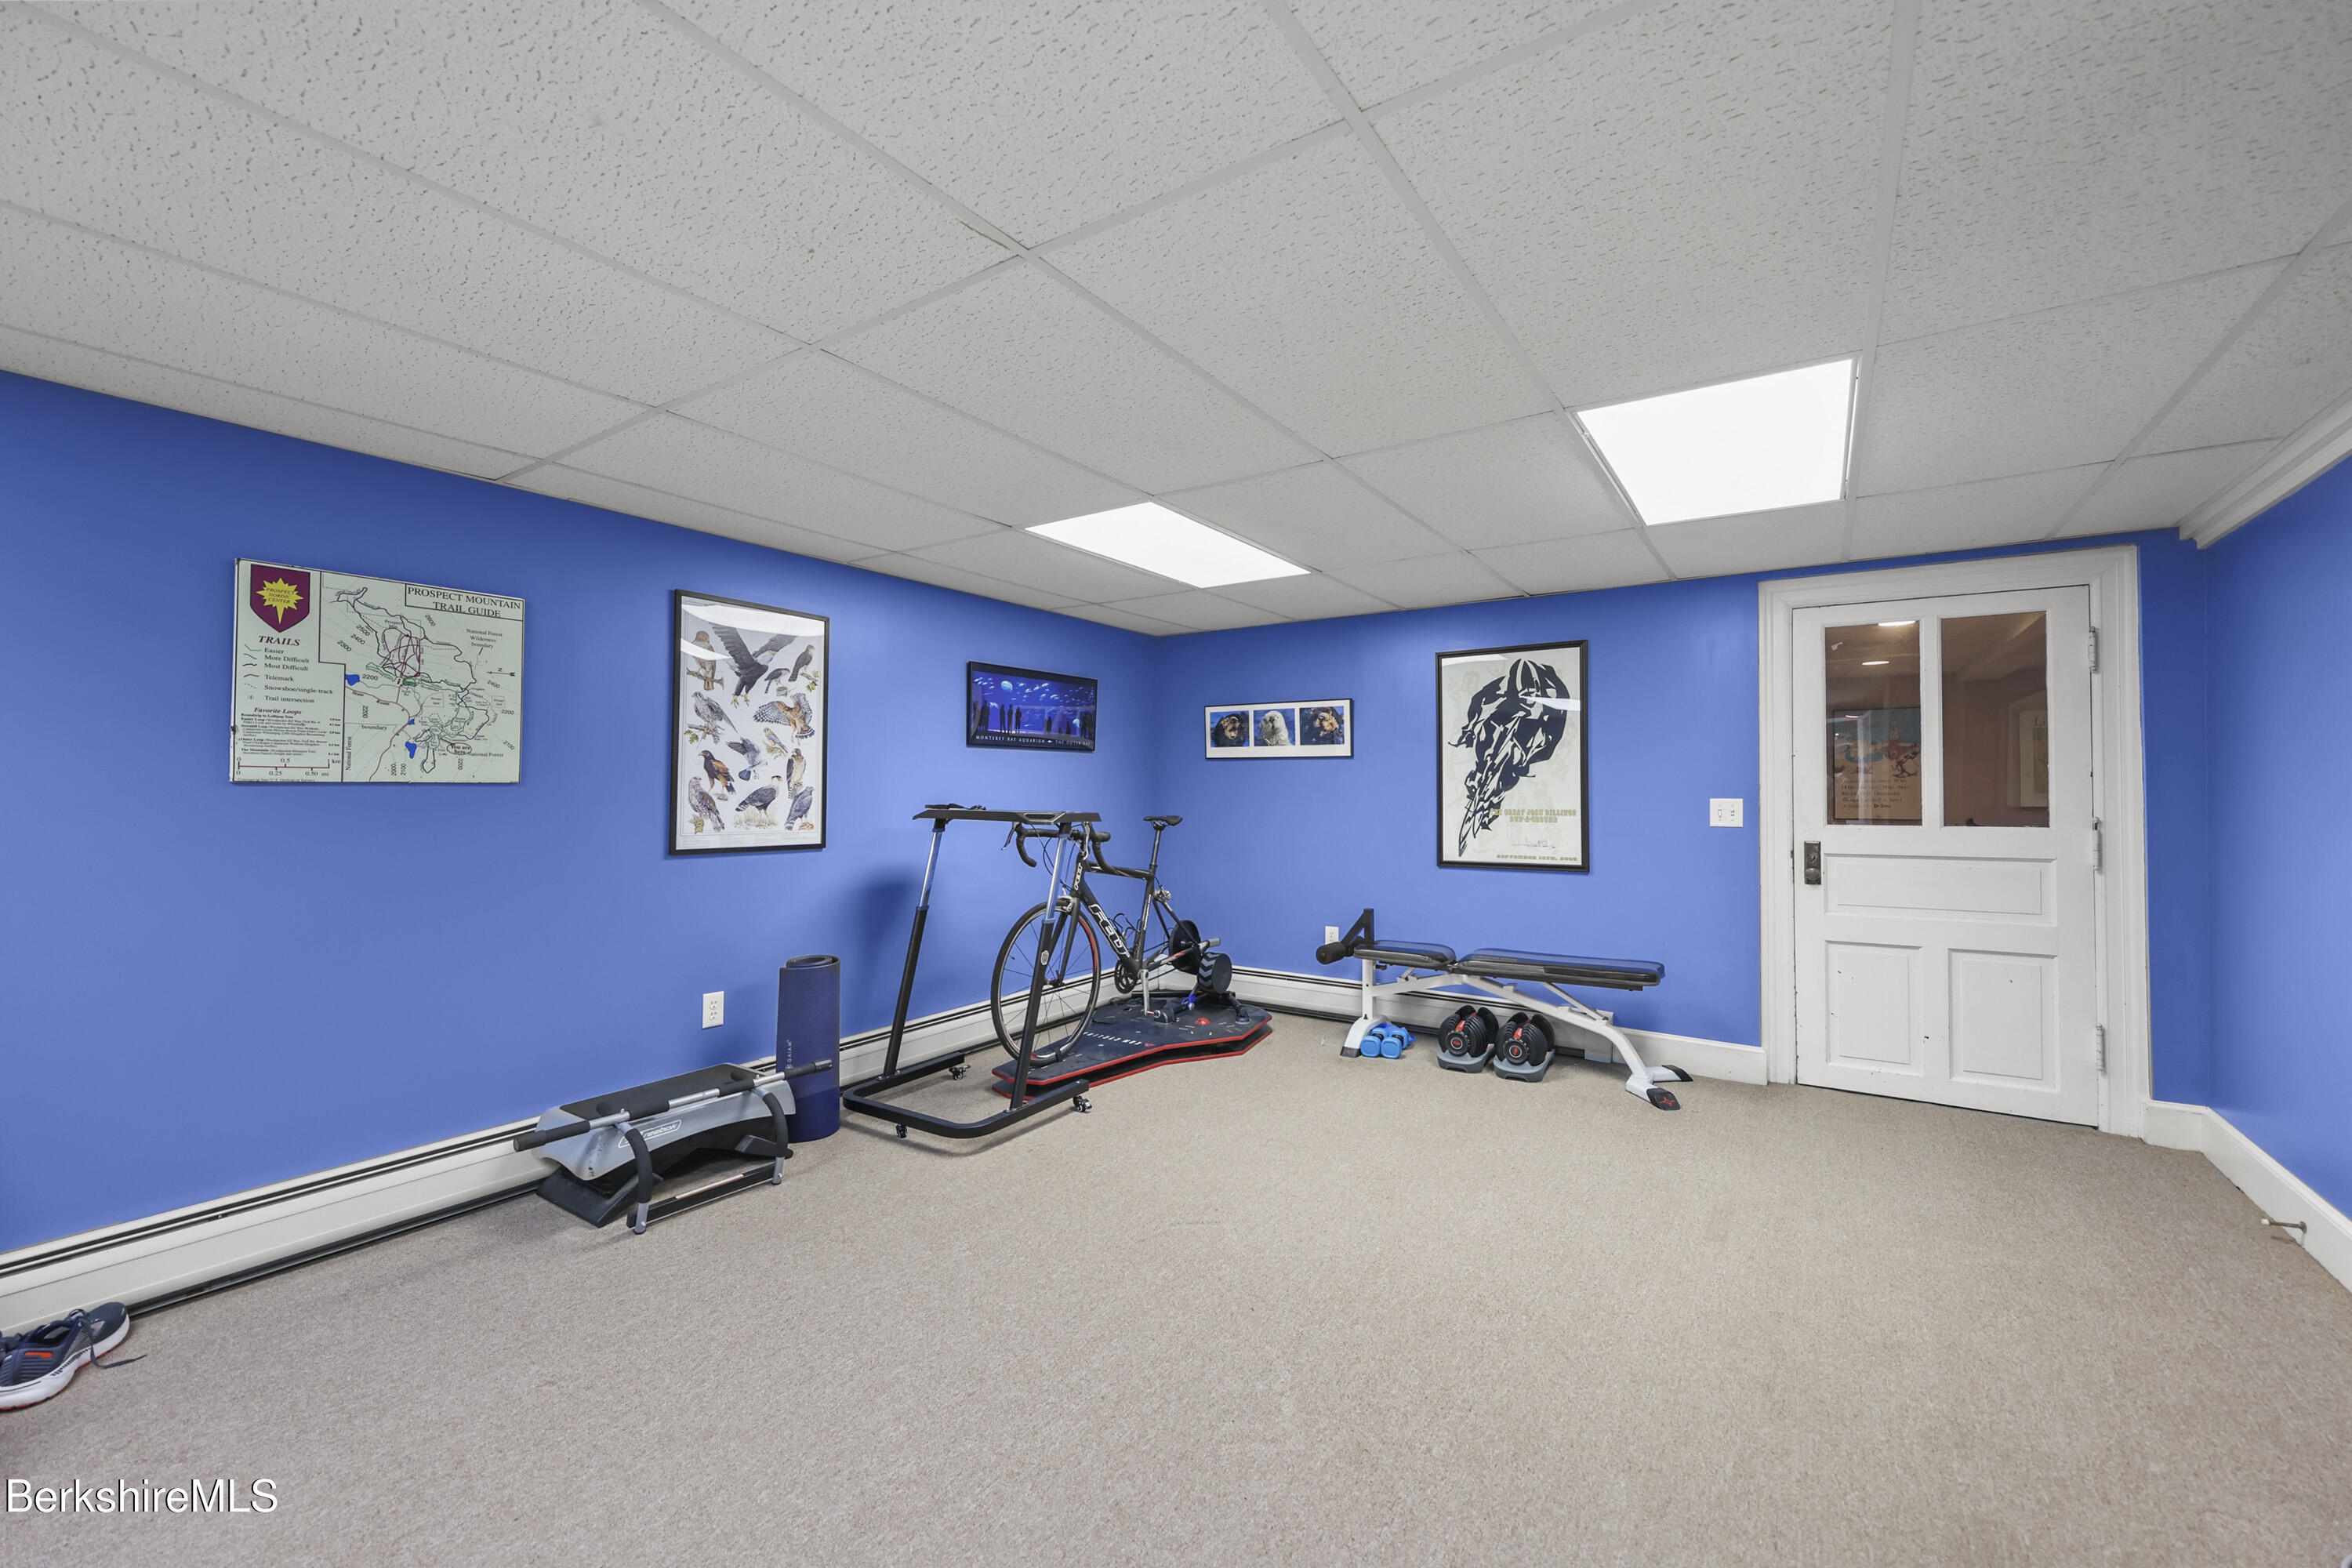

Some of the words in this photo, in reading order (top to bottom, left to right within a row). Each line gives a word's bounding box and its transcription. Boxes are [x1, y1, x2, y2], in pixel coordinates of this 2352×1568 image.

[408, 586, 464, 601] PROSPECT
[466, 595, 521, 609] MOUNTAIN
[433, 601, 466, 613] TRAIL
[468, 606, 501, 618] GUIDE
[356, 624, 370, 637] 2500
[259, 635, 301, 646] TRAILS
[350, 633, 365, 644] 2400
[337, 640, 351, 652] 2300
[487, 679, 500, 688] 2400
[264, 684, 333, 695] Snowshoe/single-track
[503, 740, 515, 751] 2100
